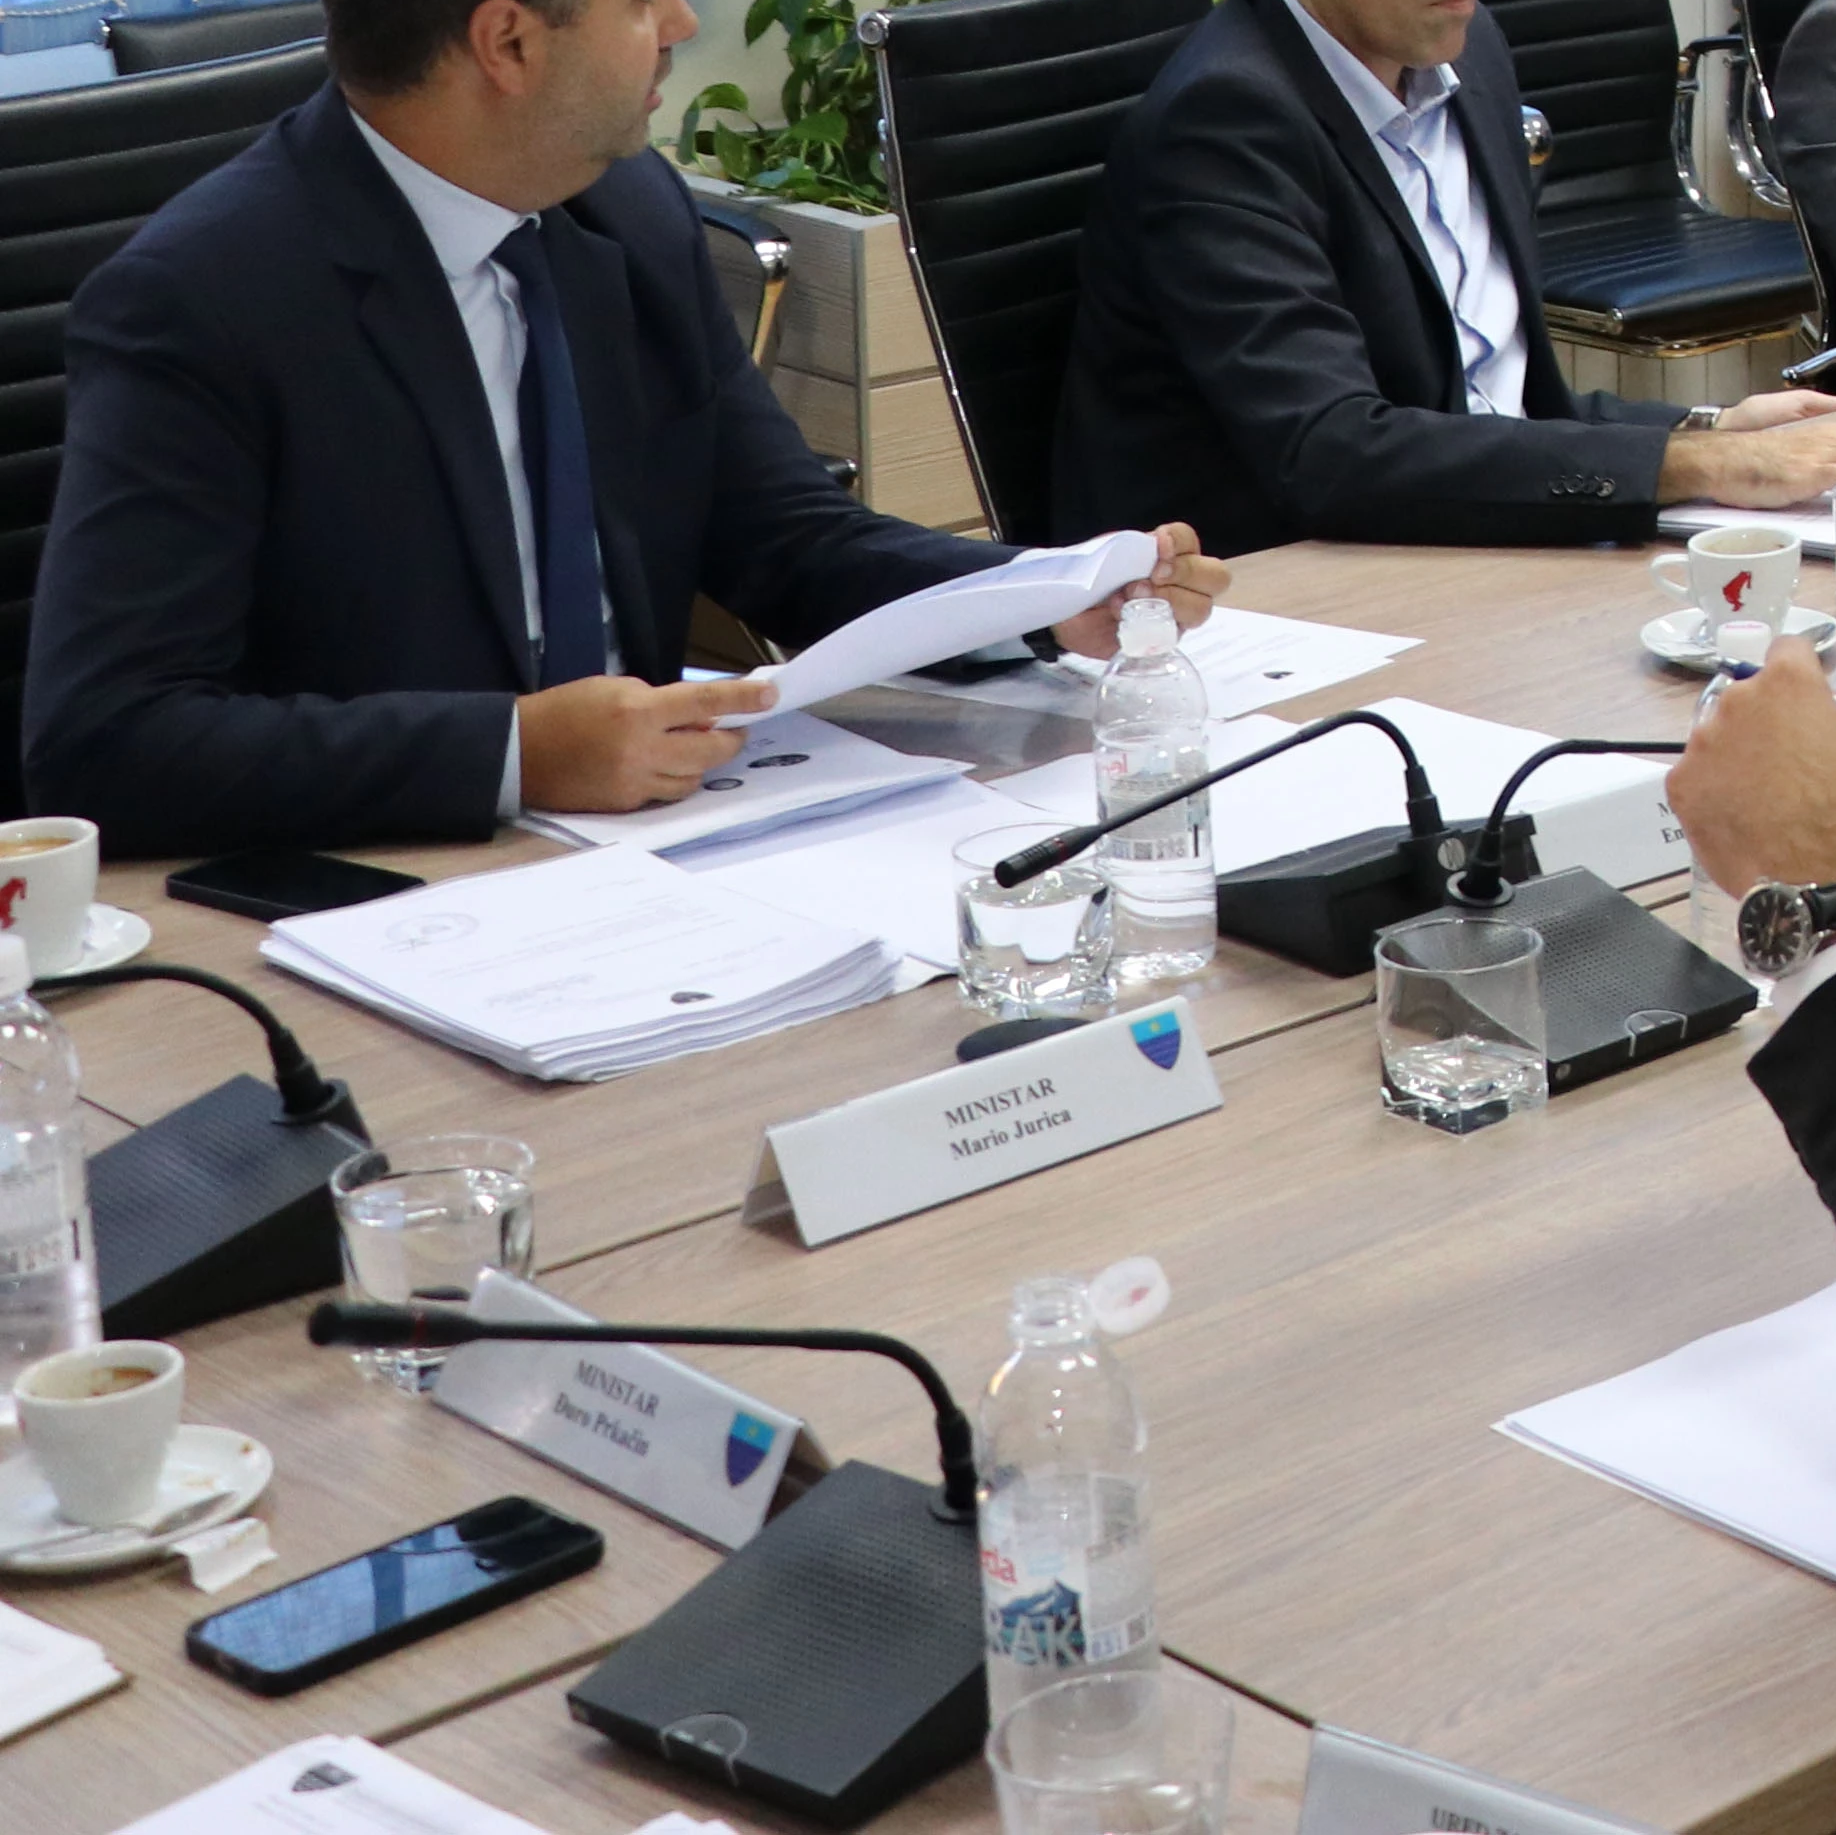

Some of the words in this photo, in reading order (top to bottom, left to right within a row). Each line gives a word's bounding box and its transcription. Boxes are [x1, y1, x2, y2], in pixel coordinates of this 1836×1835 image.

[944, 1078, 1057, 1129] MINISTAR
[950, 1129, 1009, 1161] Mario
[1014, 1109, 1072, 1139] Jurica
[576, 1358, 659, 1418] MINISTAR
